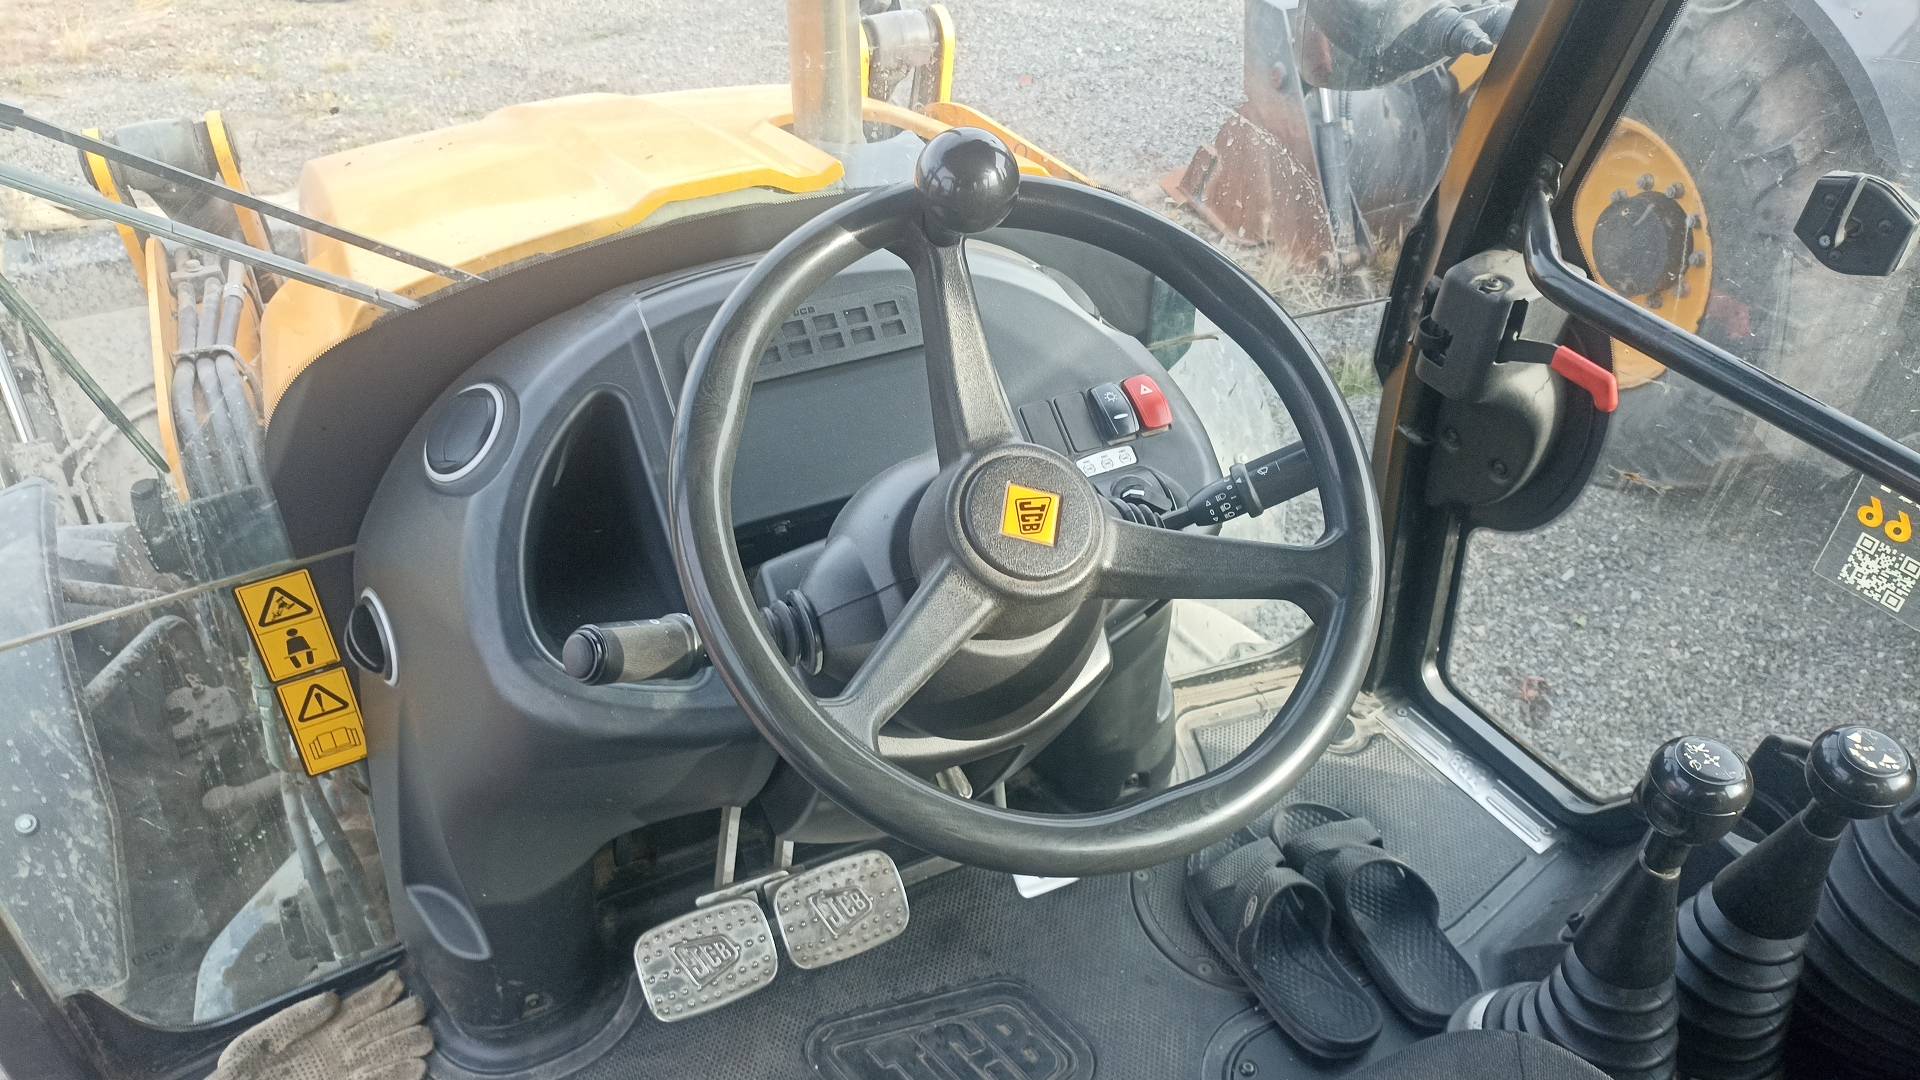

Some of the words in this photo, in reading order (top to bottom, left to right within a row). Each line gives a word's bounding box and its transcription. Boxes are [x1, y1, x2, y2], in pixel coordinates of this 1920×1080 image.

[1019, 501, 1046, 532] JCB
[822, 893, 866, 928] JCB
[686, 942, 731, 978] JCB
